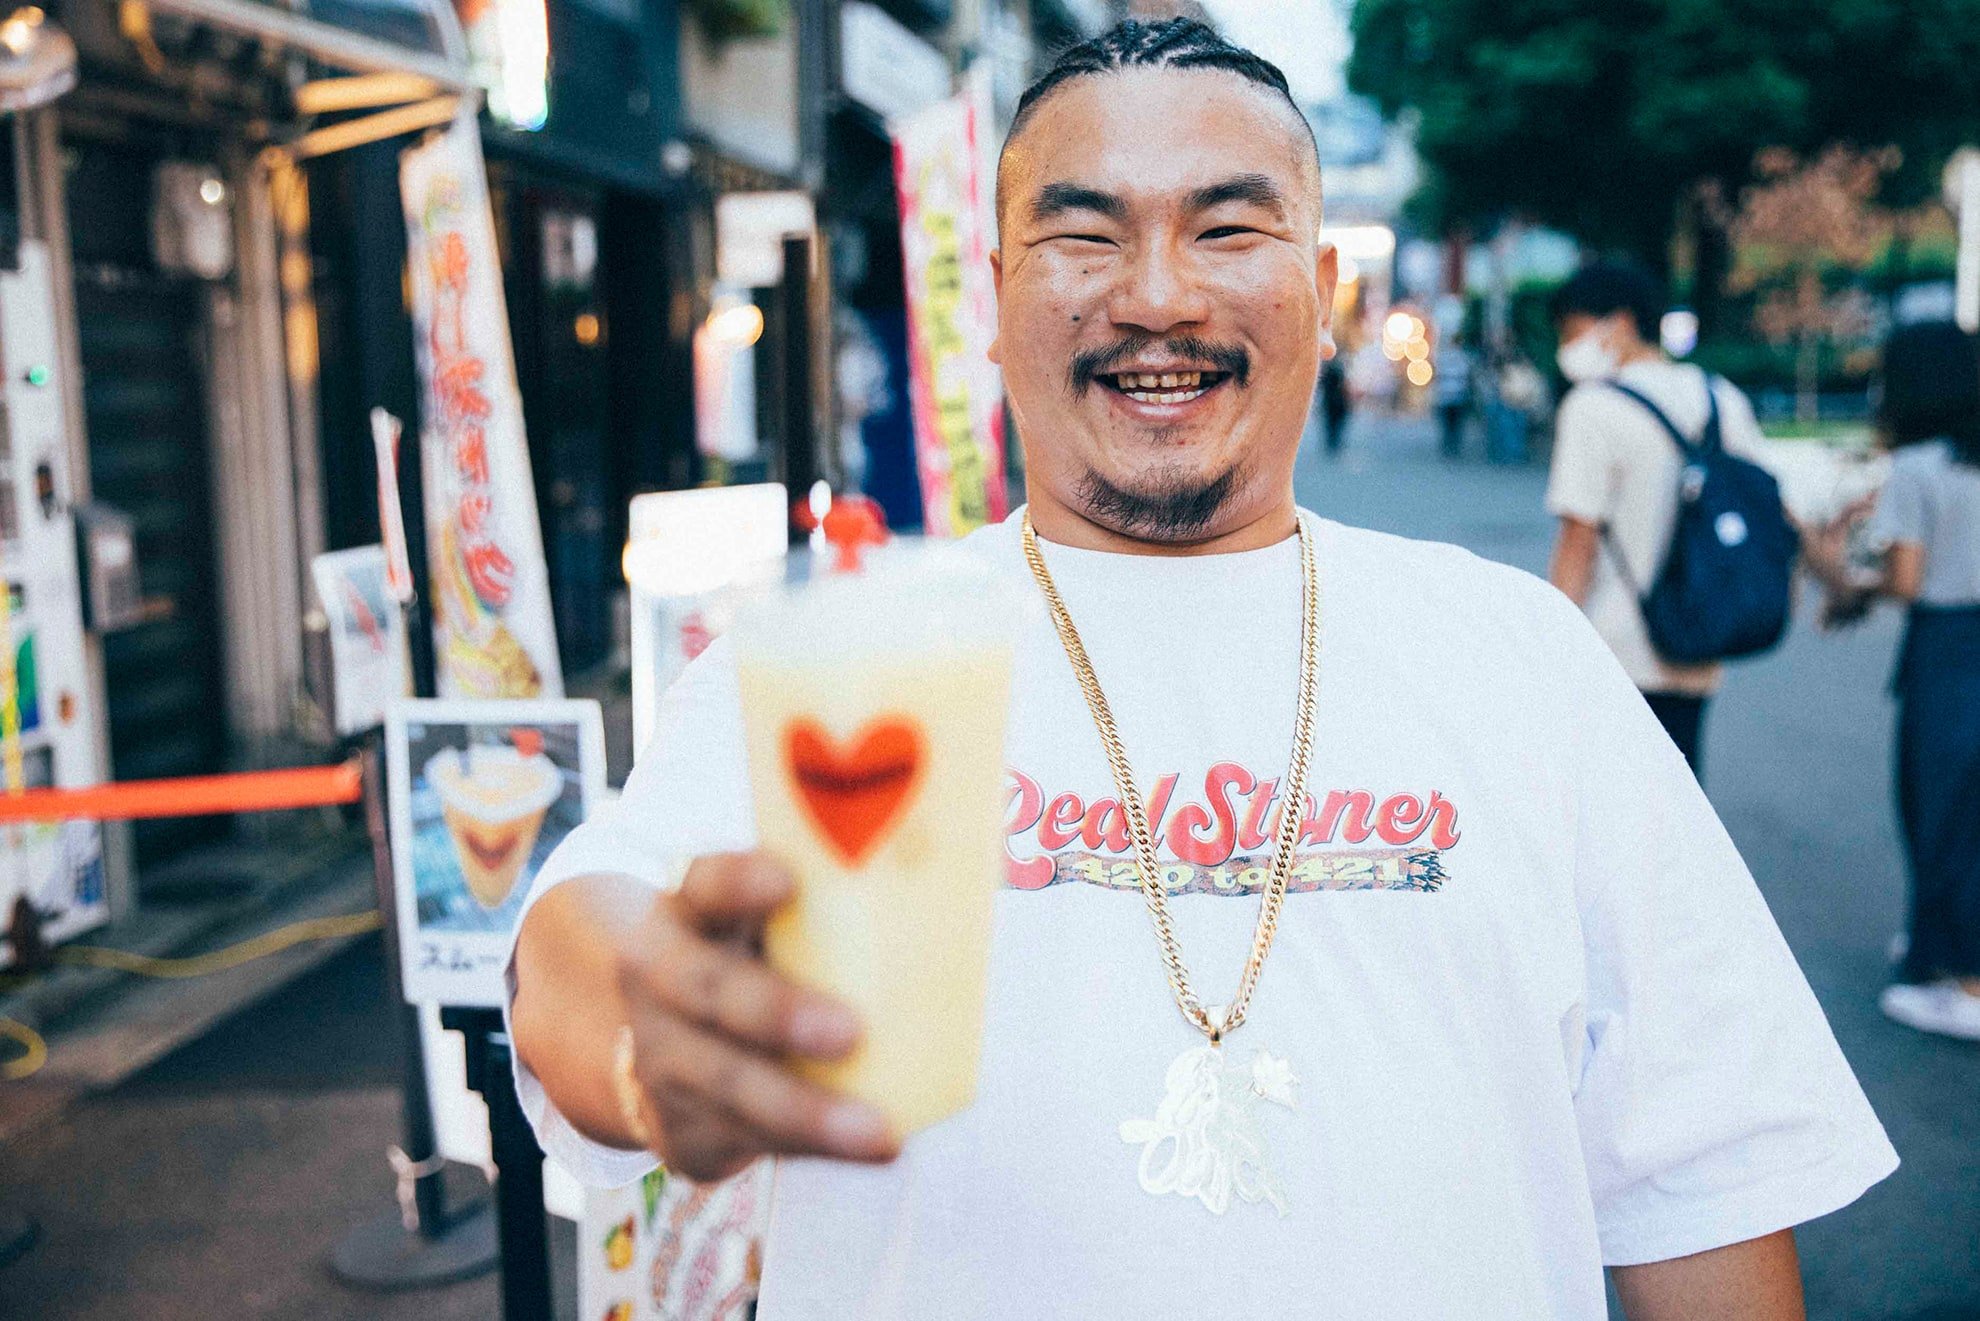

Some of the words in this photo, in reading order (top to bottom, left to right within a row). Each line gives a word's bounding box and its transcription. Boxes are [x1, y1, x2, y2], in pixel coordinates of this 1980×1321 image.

[1072, 858, 1195, 888] 420
[1208, 864, 1270, 890] to
[1290, 856, 1406, 883] 421
